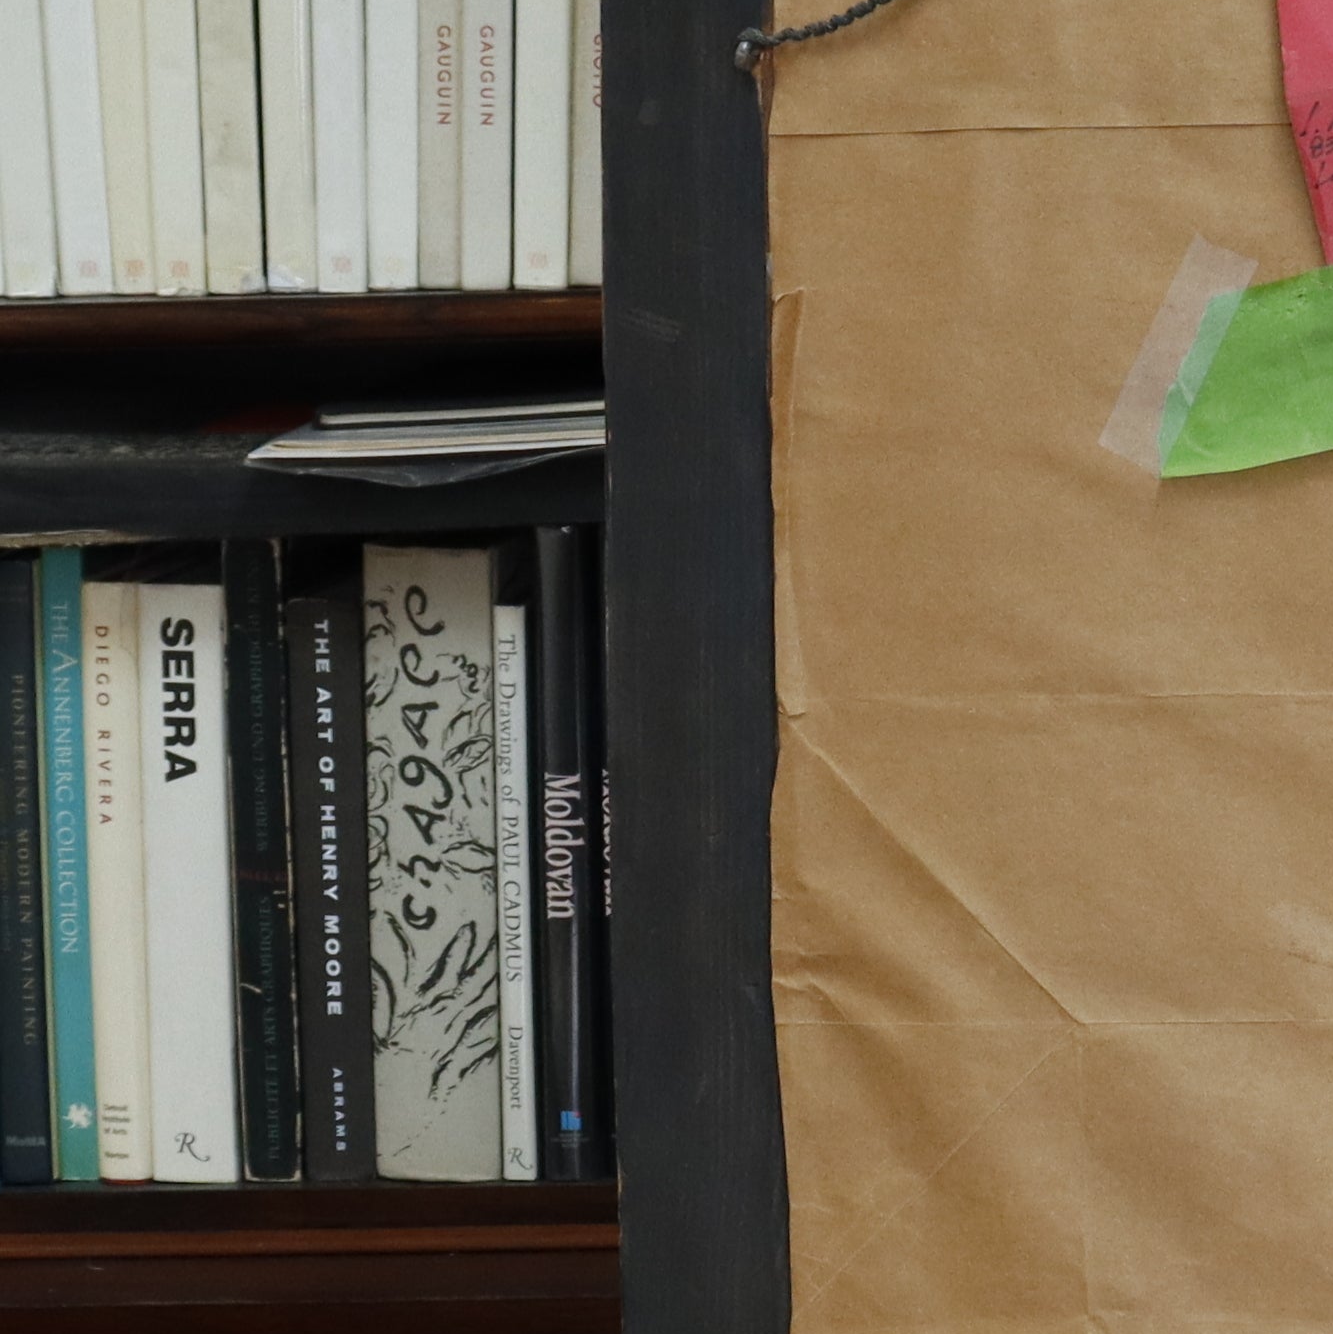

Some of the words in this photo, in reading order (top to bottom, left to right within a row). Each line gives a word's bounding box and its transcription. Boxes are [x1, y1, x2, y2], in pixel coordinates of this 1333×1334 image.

[437, 25, 452, 125] GAUGUIN
[480, 25, 495, 126] GAUGUIN
[49, 604, 70, 644] THE
[94, 624, 112, 707] DIEGO
[313, 618, 331, 674] THE
[497, 634, 517, 673] The
[10, 673, 29, 816] PIONEERING
[51, 648, 79, 804] ANNENBERG
[158, 616, 198, 783] SERRA
[316, 686, 335, 743] ART
[494, 681, 517, 776] Drawings
[96, 729, 114, 826] RIVERA
[318, 755, 336, 794] OF
[502, 784, 520, 807] of
[14, 828, 33, 923] MODERN
[55, 809, 79, 954] COLLECTION
[320, 804, 339, 901] HENRY
[501, 814, 520, 874] PAUL
[543, 770, 581, 920] Moldovan
[323, 914, 343, 1017] MOORE
[502, 879, 523, 983] CADMUS
[19, 937, 38, 1046] PAINTING
[332, 1068, 348, 1152] ABRAMS
[505, 1026, 524, 1111] Davenport
